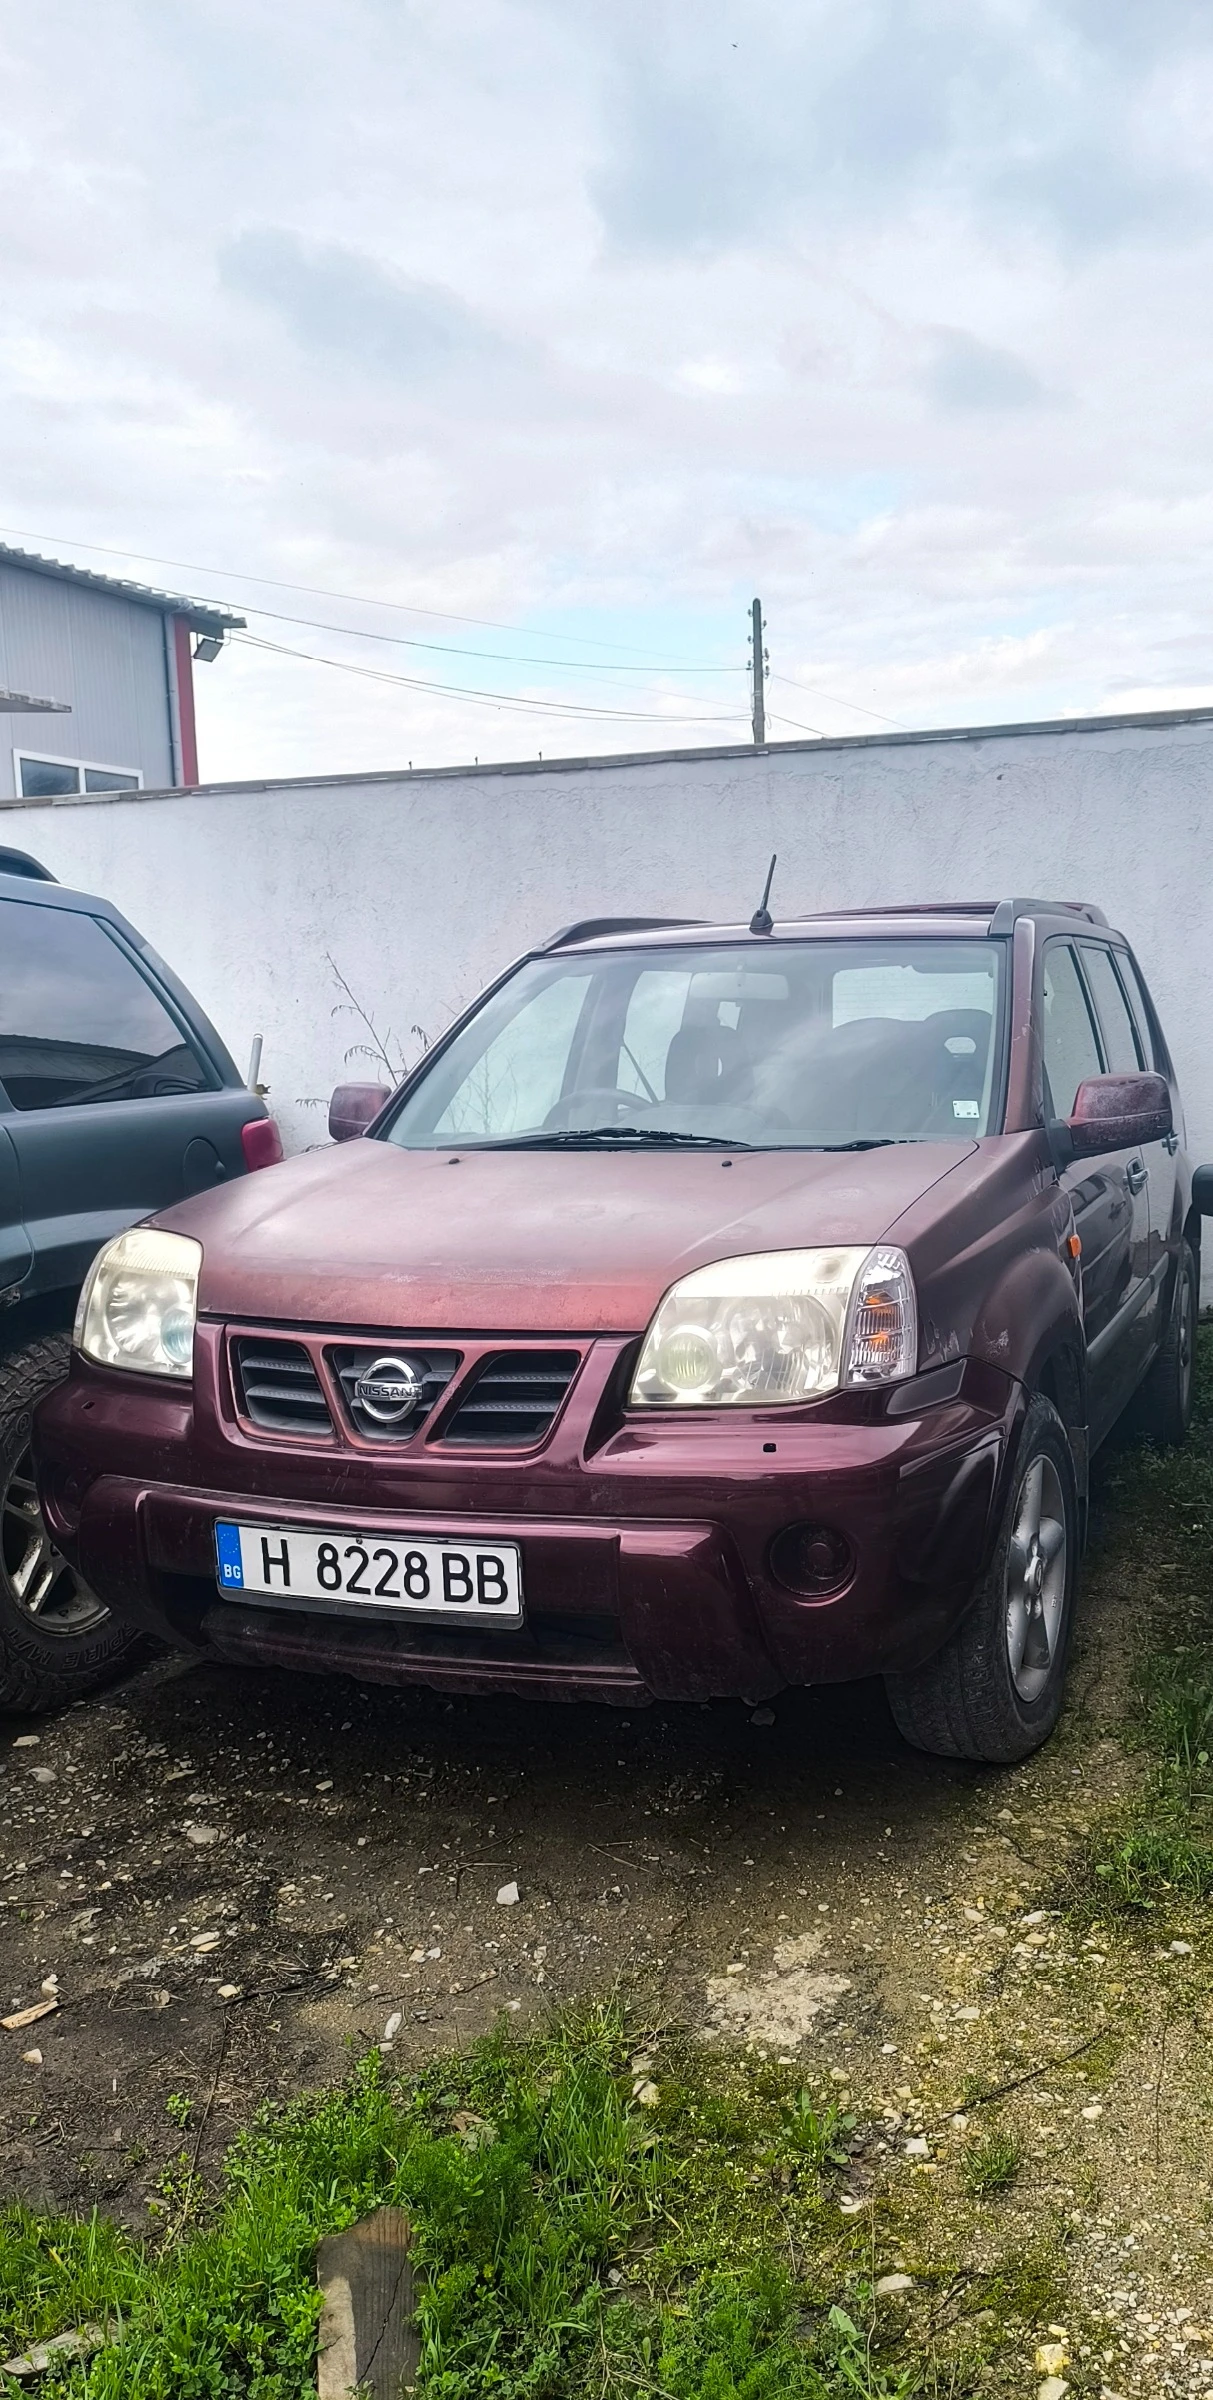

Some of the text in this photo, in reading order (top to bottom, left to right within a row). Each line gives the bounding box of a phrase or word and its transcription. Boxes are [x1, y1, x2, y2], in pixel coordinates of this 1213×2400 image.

[360, 1385, 413, 1398] NISSAN
[223, 1563, 242, 1580] BG
[260, 1536, 509, 1605] H 8228 BB
